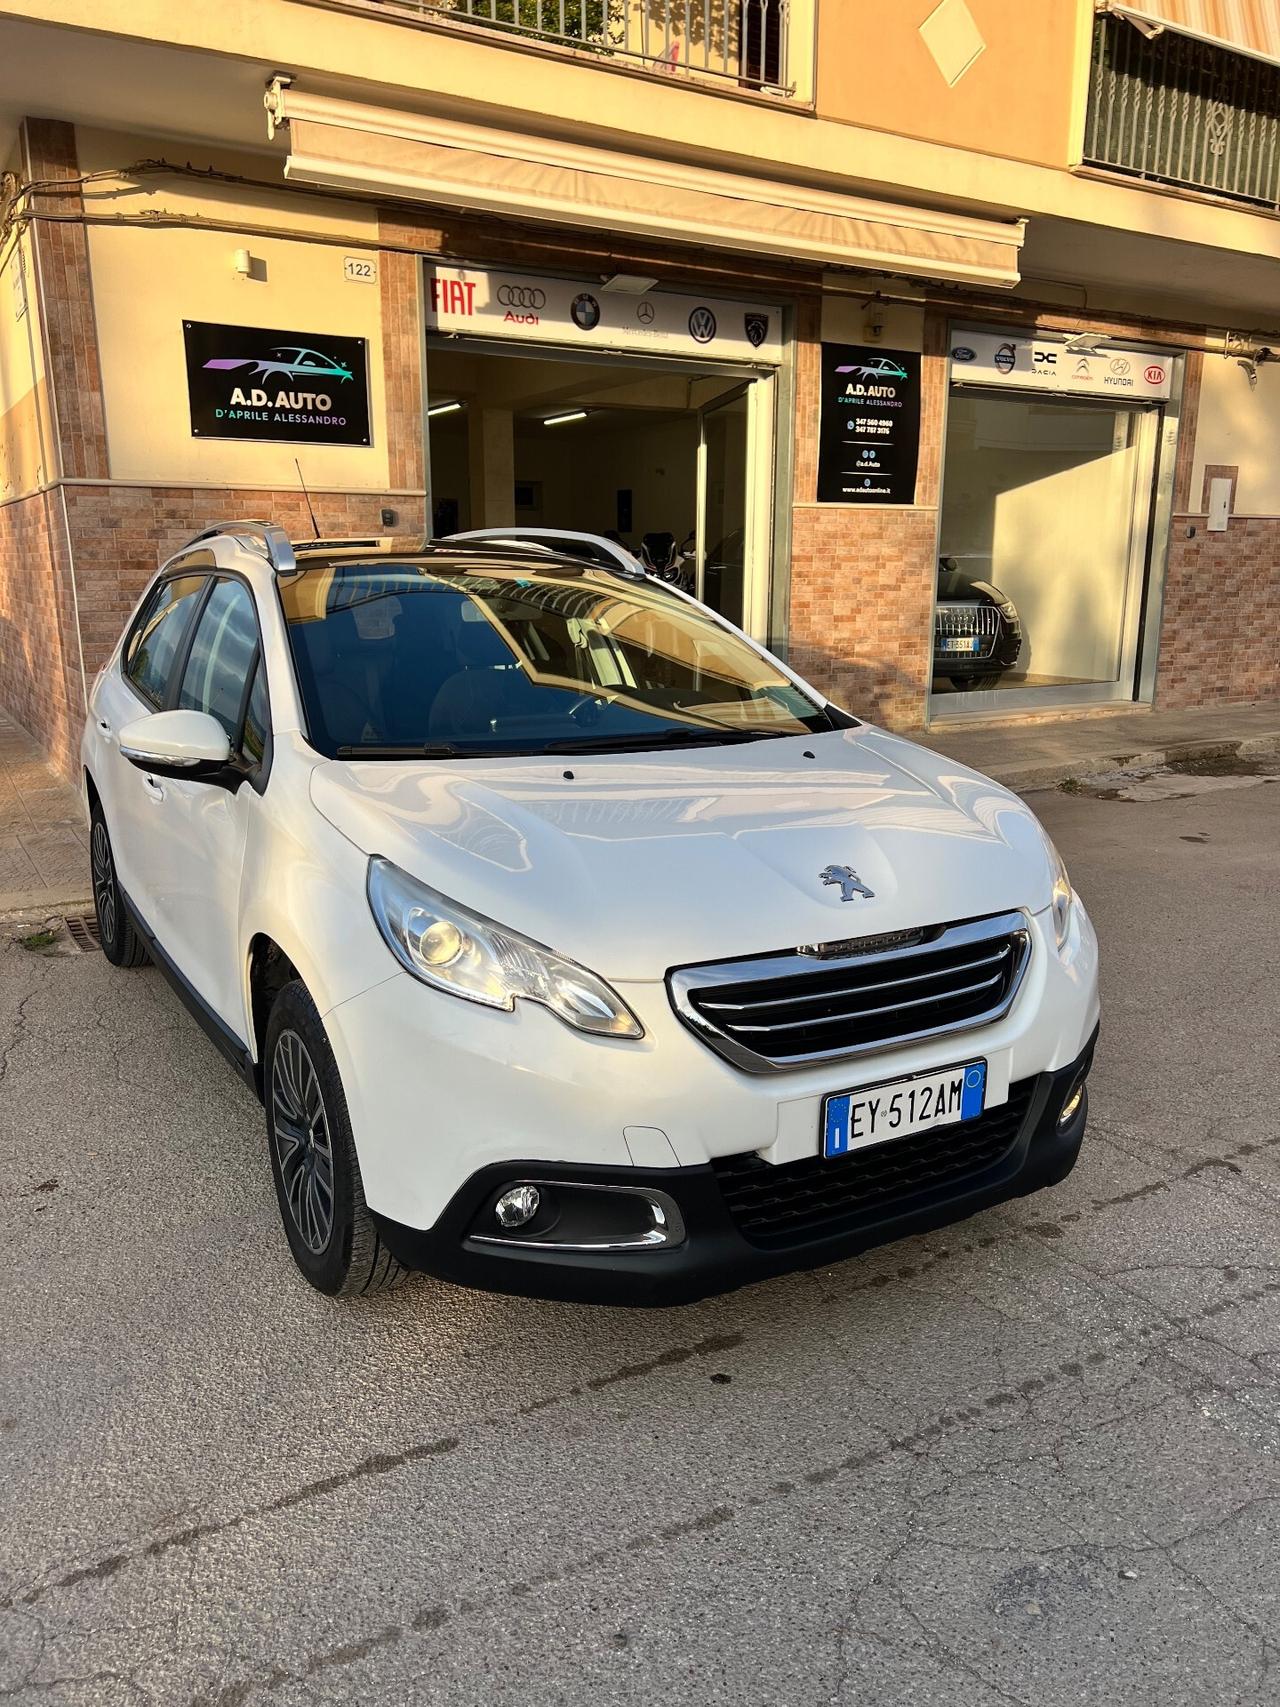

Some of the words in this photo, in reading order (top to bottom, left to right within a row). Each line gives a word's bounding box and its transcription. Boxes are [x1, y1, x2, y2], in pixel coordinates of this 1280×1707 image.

[348, 263, 371, 277] 122
[430, 278, 476, 316] FIAT
[504, 311, 539, 325] Audi
[1031, 368, 1057, 377] DACIA
[1147, 369, 1162, 381] KIA
[1103, 376, 1134, 387] HYUNDAI
[845, 382, 867, 396] A.D.
[867, 385, 896, 398] AUTO
[230, 387, 273, 408] A.D.
[274, 391, 332, 411] AUTO
[866, 399, 903, 408] ALESSANDRO
[215, 408, 269, 421] D'APRILE
[274, 413, 347, 426] ALESSANDRO
[850, 1098, 881, 1139] EY
[889, 1078, 963, 1128] 512AM
